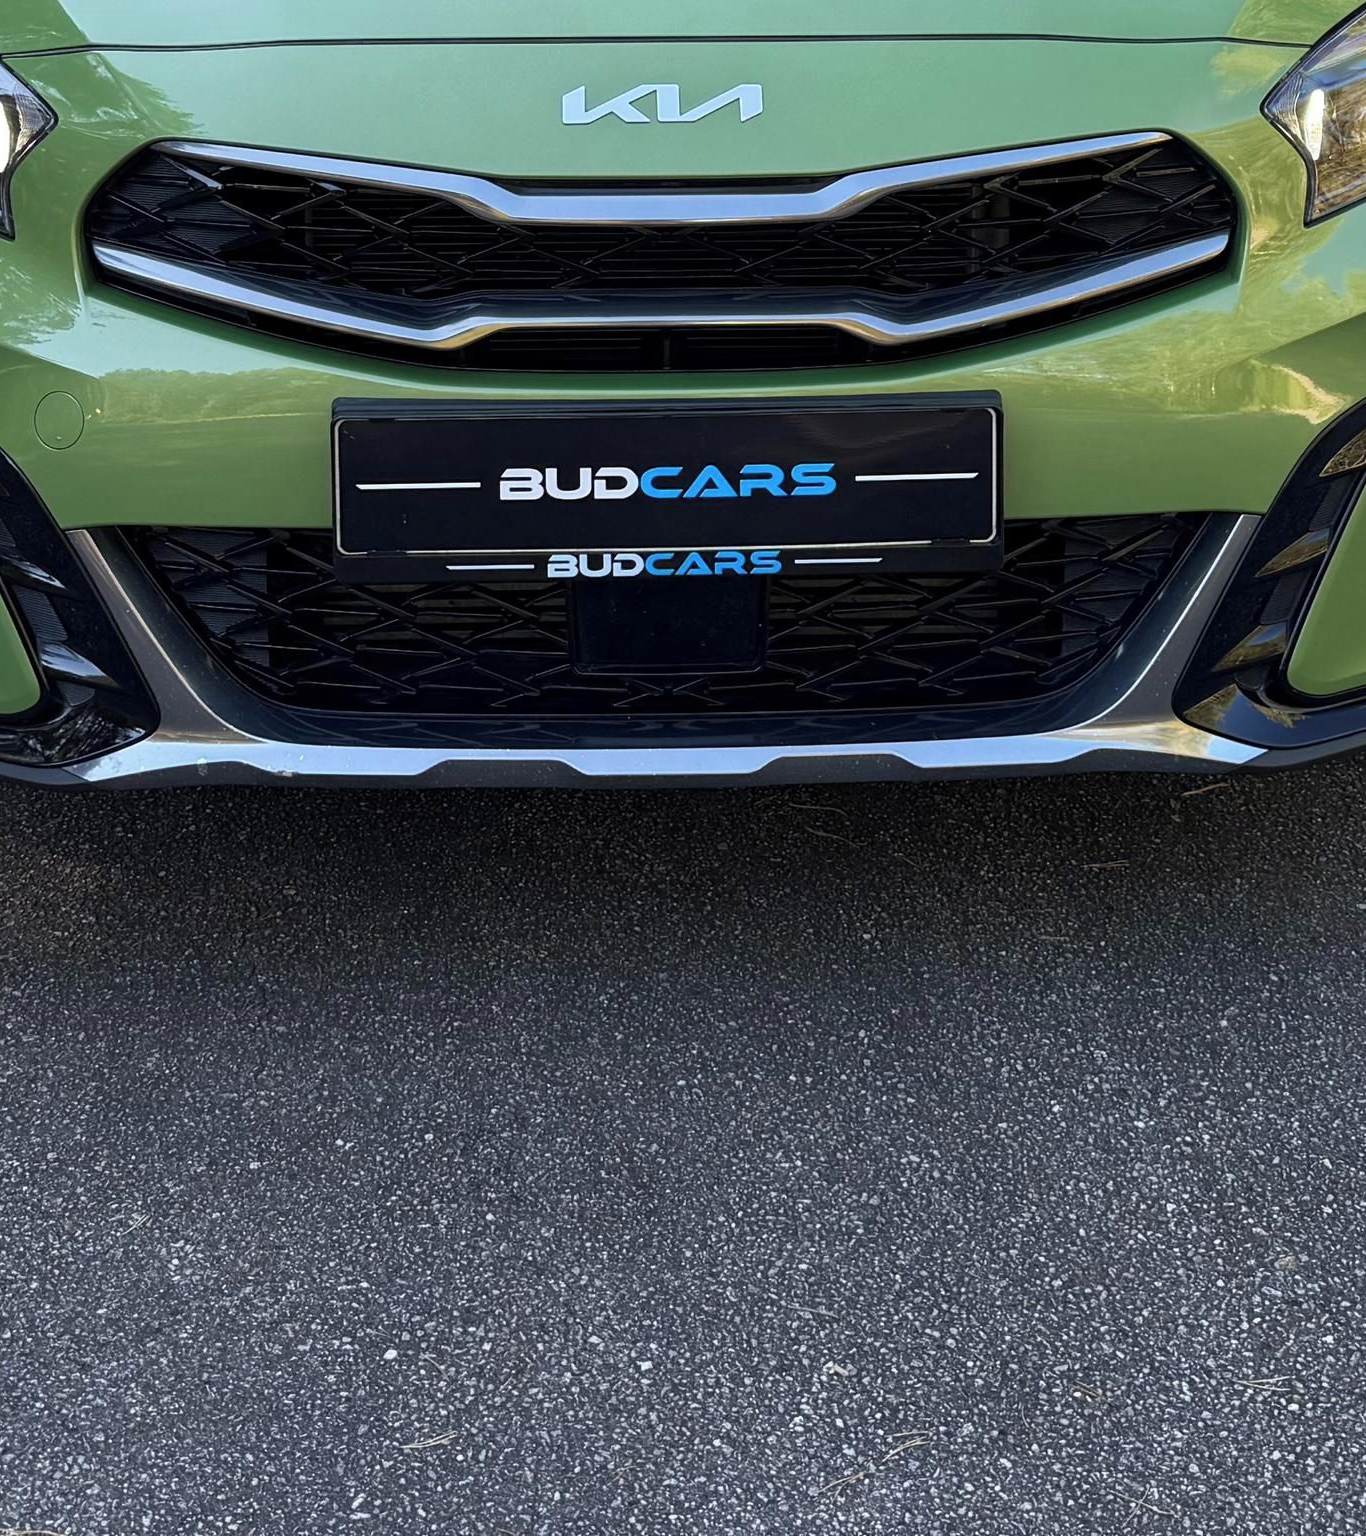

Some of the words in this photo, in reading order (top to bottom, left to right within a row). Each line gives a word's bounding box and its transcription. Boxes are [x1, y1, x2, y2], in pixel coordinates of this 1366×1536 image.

[562, 83, 763, 125] KIA
[499, 462, 837, 501] BUDCARS
[546, 550, 783, 579] BUDCARS
